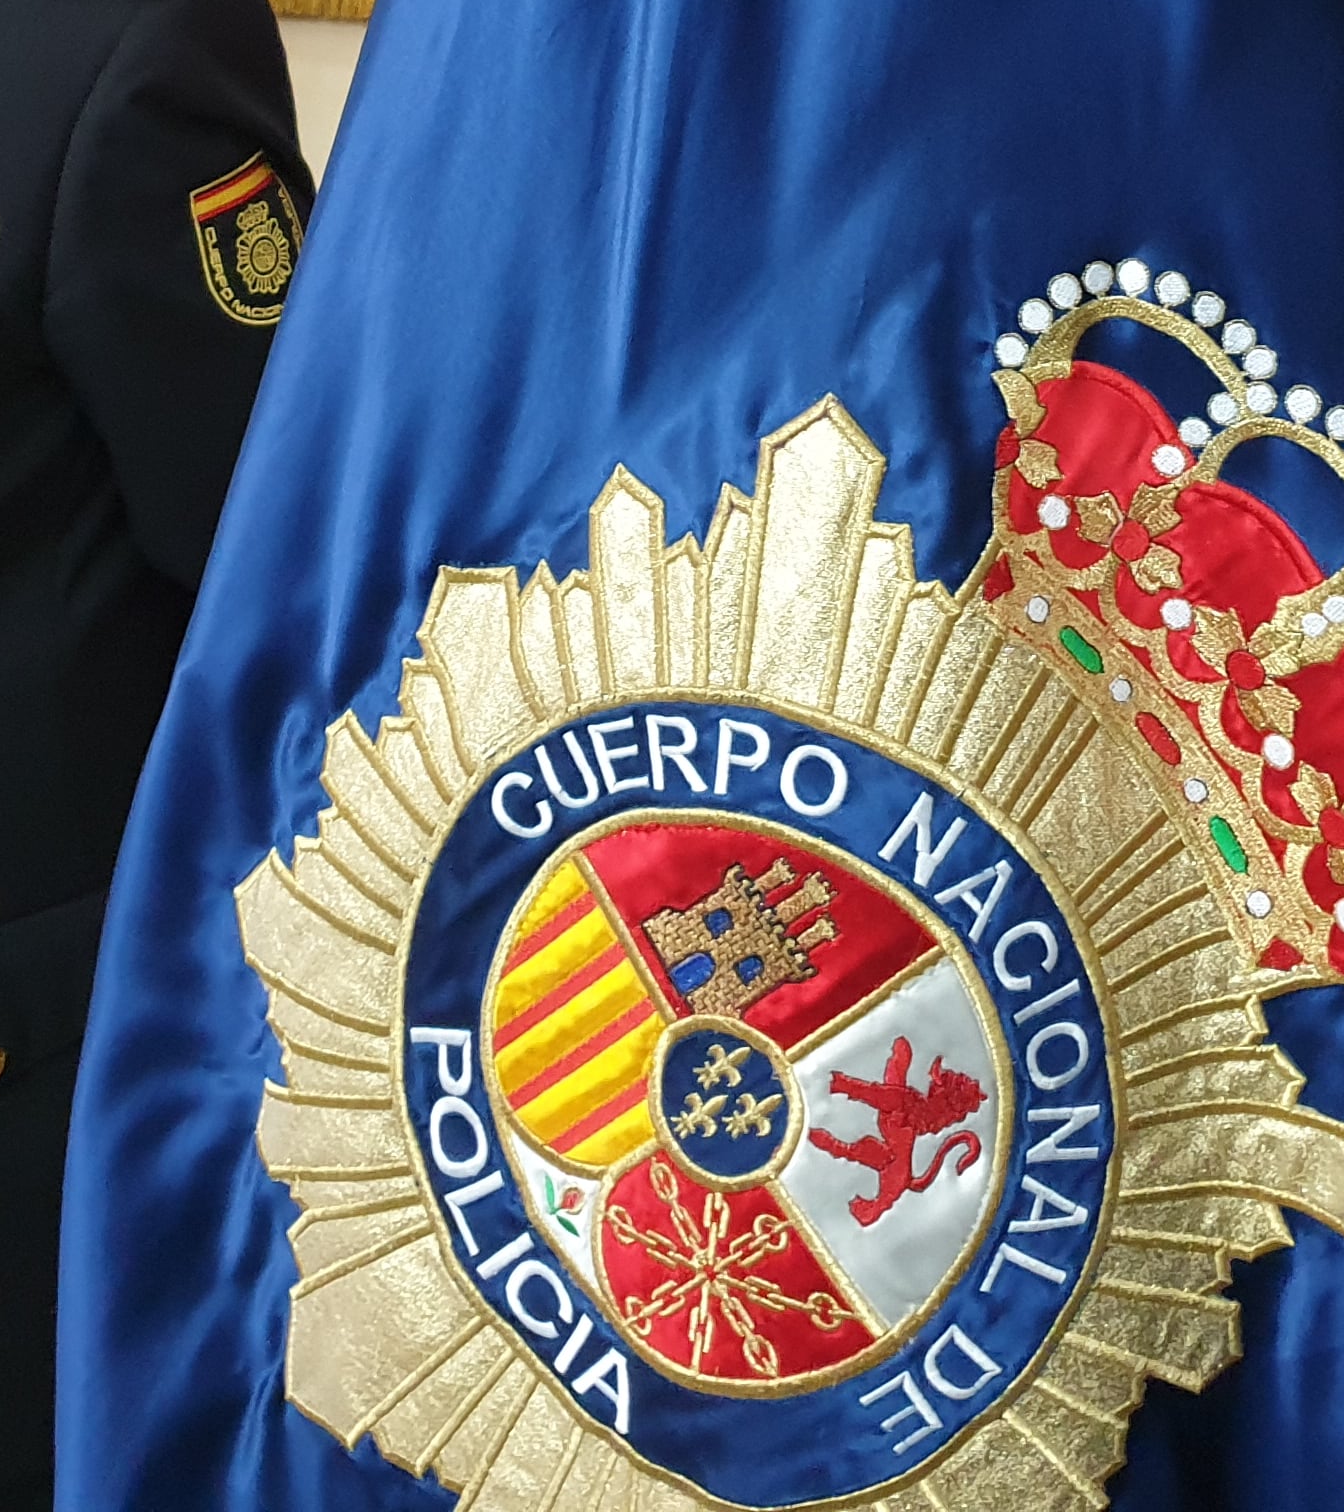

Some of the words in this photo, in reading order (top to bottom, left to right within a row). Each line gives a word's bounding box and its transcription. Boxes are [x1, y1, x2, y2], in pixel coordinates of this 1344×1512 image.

[490, 713, 849, 839] CUERPO
[877, 790, 1101, 1294] NACIONAL
[410, 1026, 630, 1435] POLICIA
[859, 1324, 1003, 1455] DE
